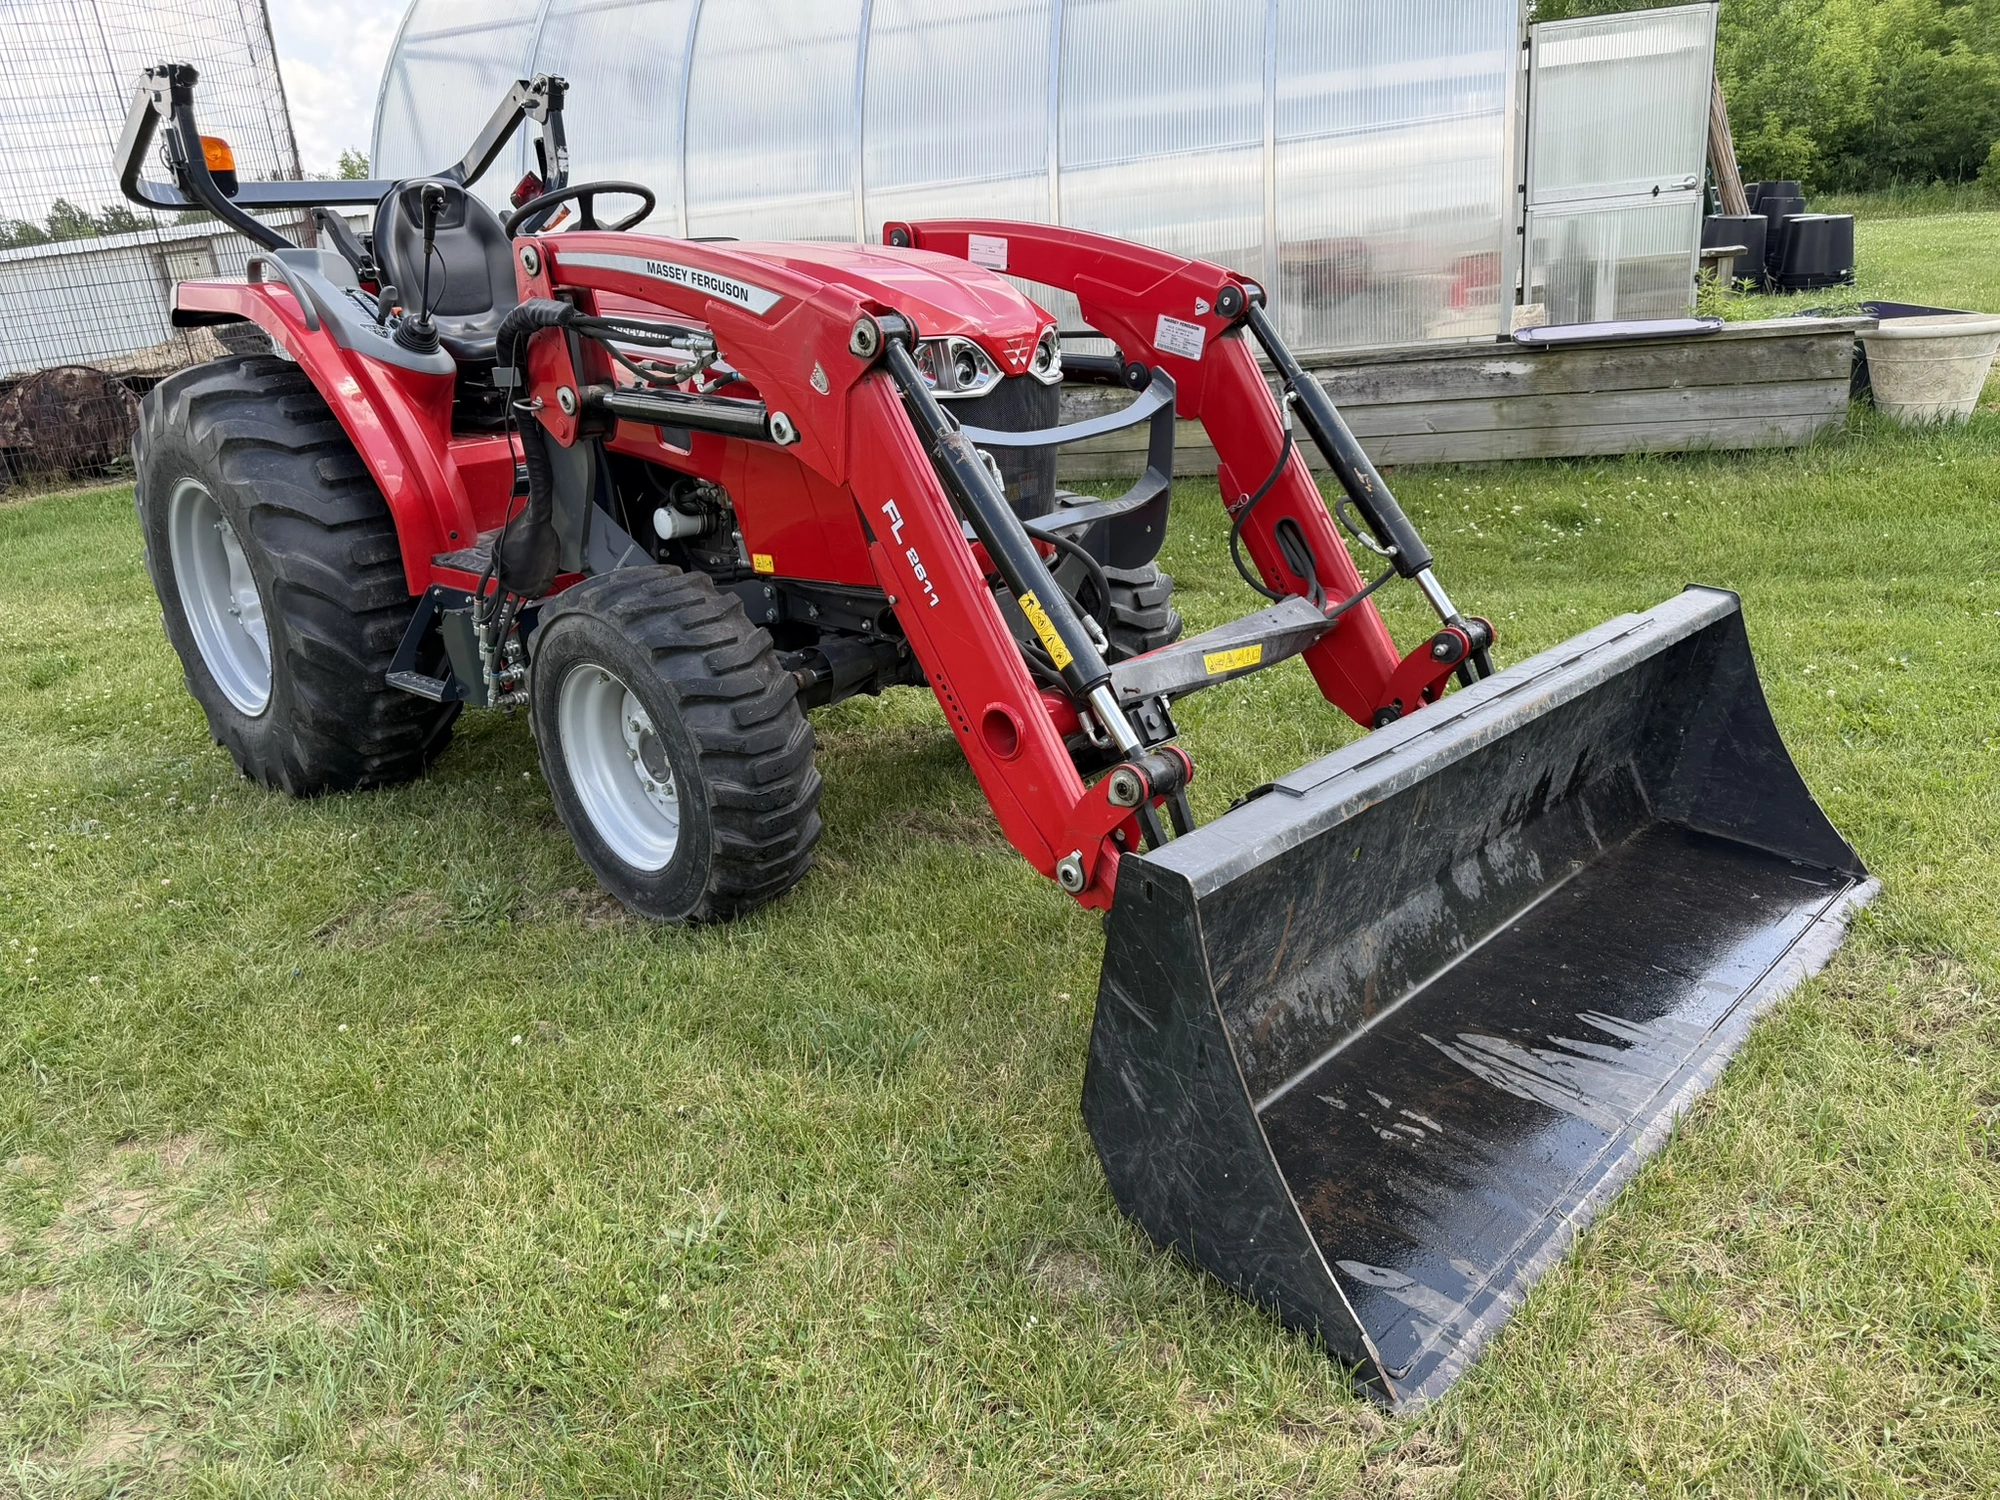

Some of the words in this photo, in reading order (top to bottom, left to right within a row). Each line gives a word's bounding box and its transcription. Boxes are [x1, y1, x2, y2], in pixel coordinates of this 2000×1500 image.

[646, 261, 688, 282] MASSEY
[691, 271, 749, 302] FERGUSON
[881, 498, 905, 546] FL
[905, 547, 940, 607] 2611
